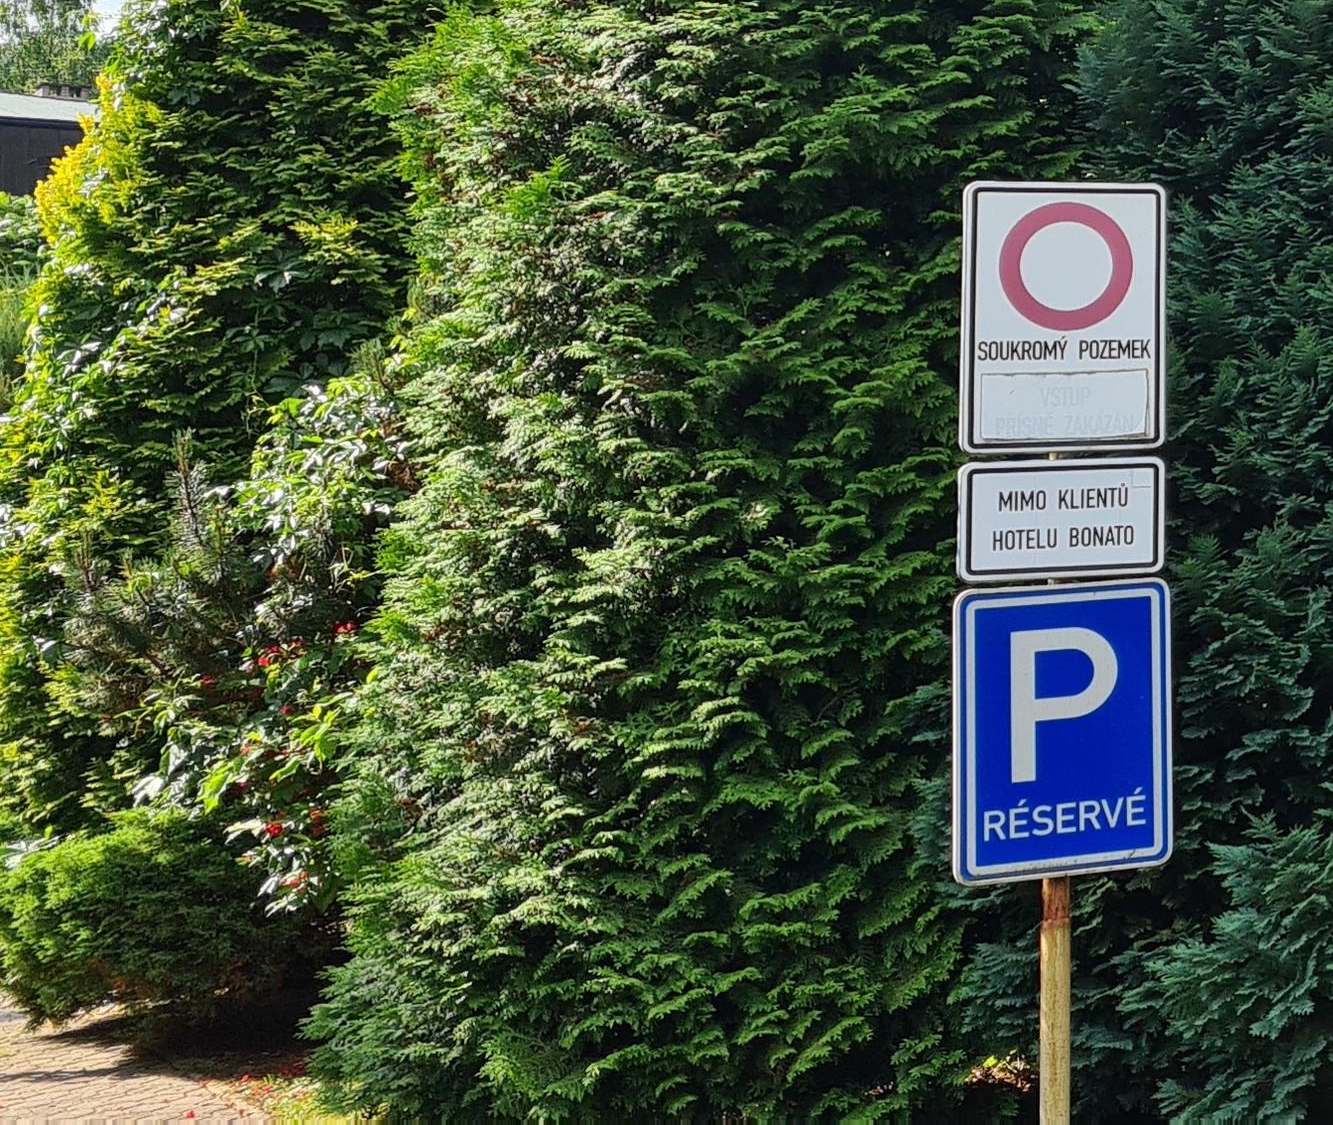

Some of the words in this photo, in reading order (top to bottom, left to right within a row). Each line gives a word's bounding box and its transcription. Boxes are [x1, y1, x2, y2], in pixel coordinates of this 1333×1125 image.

[977, 335, 1068, 361] SOUKROMÝ
[1078, 339, 1151, 360] POZEMEK
[998, 490, 1047, 512] MIMO
[1058, 482, 1128, 510] KLIENTŮ
[992, 528, 1058, 551] HOTELU
[1069, 525, 1134, 548] BONATO
[1010, 626, 1118, 784] P
[983, 786, 1146, 843] RÉSERVÉ
